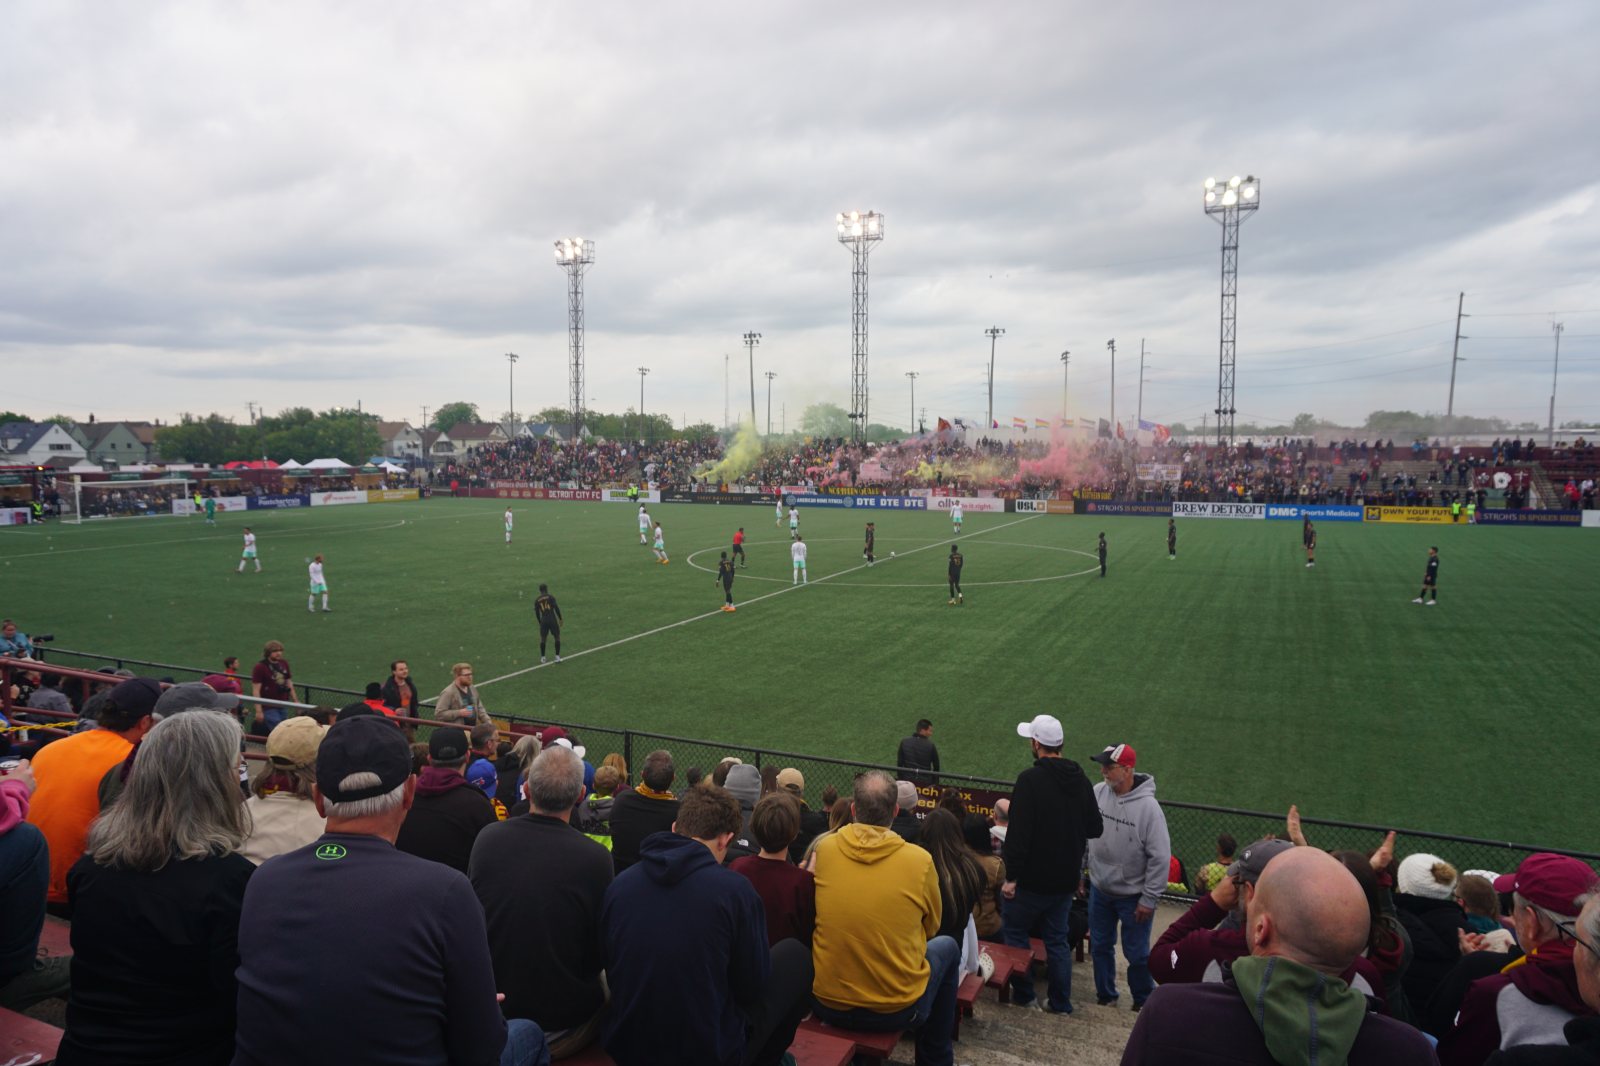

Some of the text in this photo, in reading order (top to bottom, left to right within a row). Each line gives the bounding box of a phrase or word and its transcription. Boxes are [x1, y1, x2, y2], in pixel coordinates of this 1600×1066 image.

[548, 490, 574, 498] DETROIT
[575, 491, 590, 499] CITY
[591, 491, 601, 499] FC
[856, 498, 876, 506] DTE
[880, 498, 899, 507] DTE
[904, 499, 924, 507] DTE
[1017, 501, 1037, 511] USL
[1174, 503, 1209, 513] BREW
[1211, 504, 1265, 515] DETROIT
[1269, 507, 1298, 516] DMC
[1407, 508, 1431, 516] YOUR
